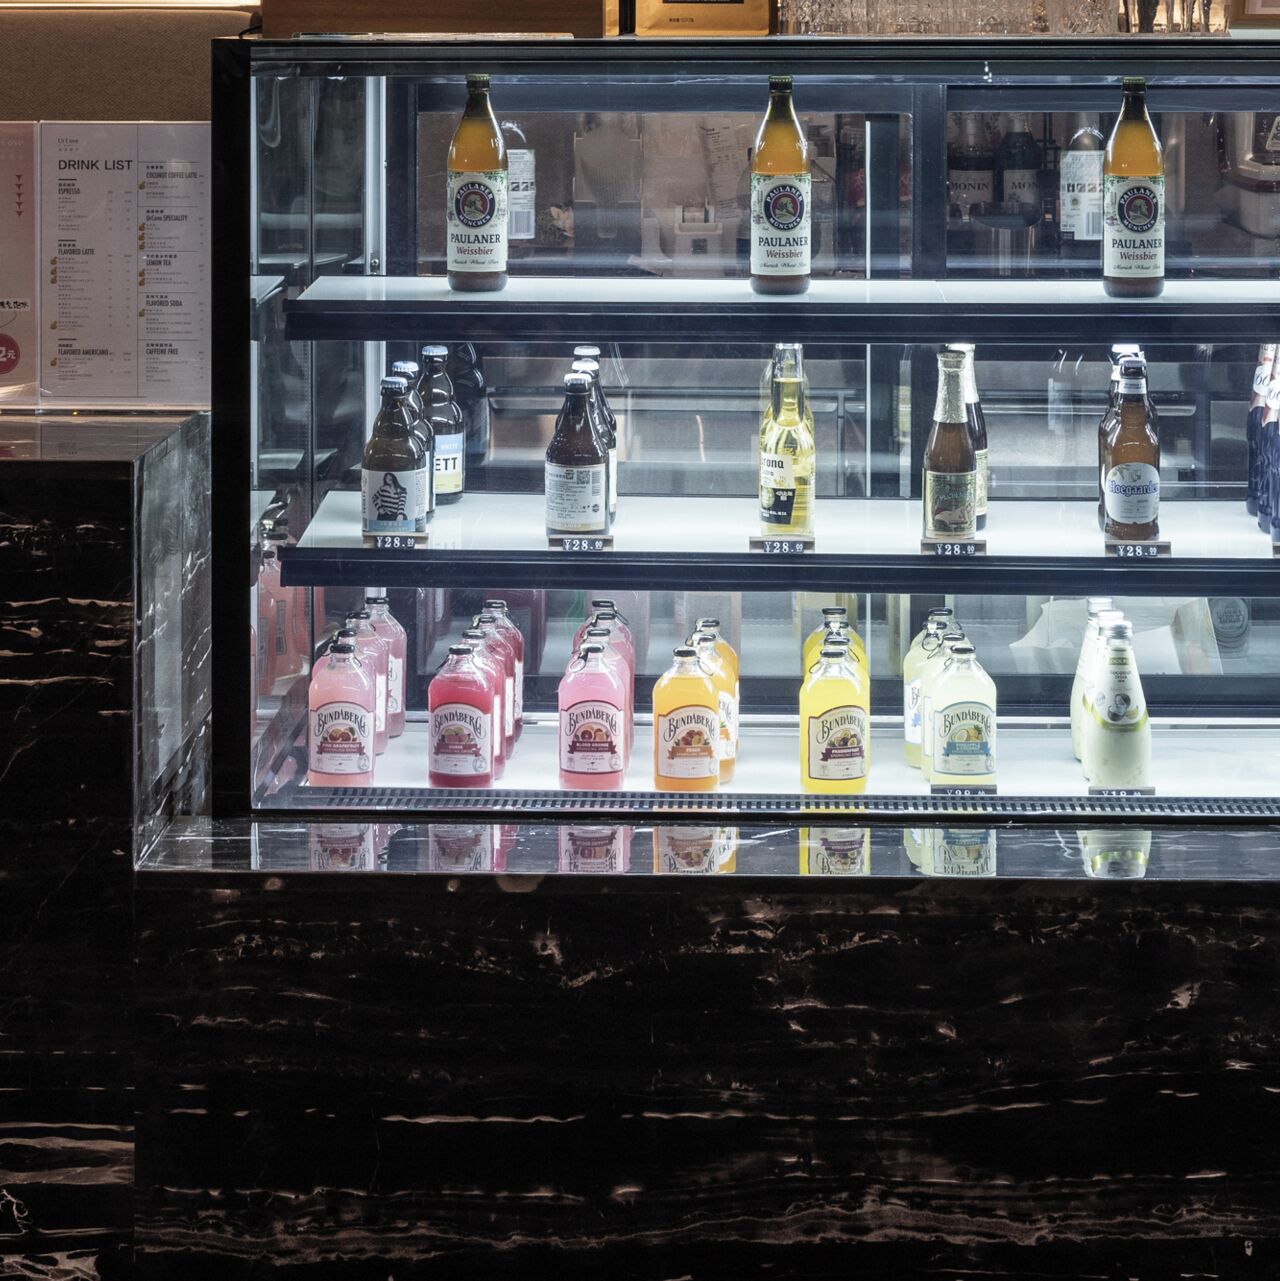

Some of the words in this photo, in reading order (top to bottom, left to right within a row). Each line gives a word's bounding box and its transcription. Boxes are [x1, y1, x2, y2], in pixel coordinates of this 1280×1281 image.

[58, 160, 100, 170] DRINK
[104, 160, 133, 170] LIST
[457, 182, 494, 200] PAULANER
[766, 184, 804, 202] PAULANER
[1120, 186, 1158, 205] PAULANER
[450, 234, 500, 244] PAULANER
[758, 237, 808, 247] PAULANER
[1112, 238, 1162, 249] PAULANER
[456, 246, 494, 256] Weissbier
[766, 249, 803, 259] Weissbier
[1120, 251, 1158, 261] Weissbier
[1108, 480, 1158, 497] Hoegaarden
[314, 708, 369, 738] BUNDABERG
[432, 710, 486, 739] BUNDABERG
[565, 708, 618, 736] BUNDABERG
[664, 714, 715, 742] BUNDABERG
[939, 709, 992, 738] BUNDABERG
